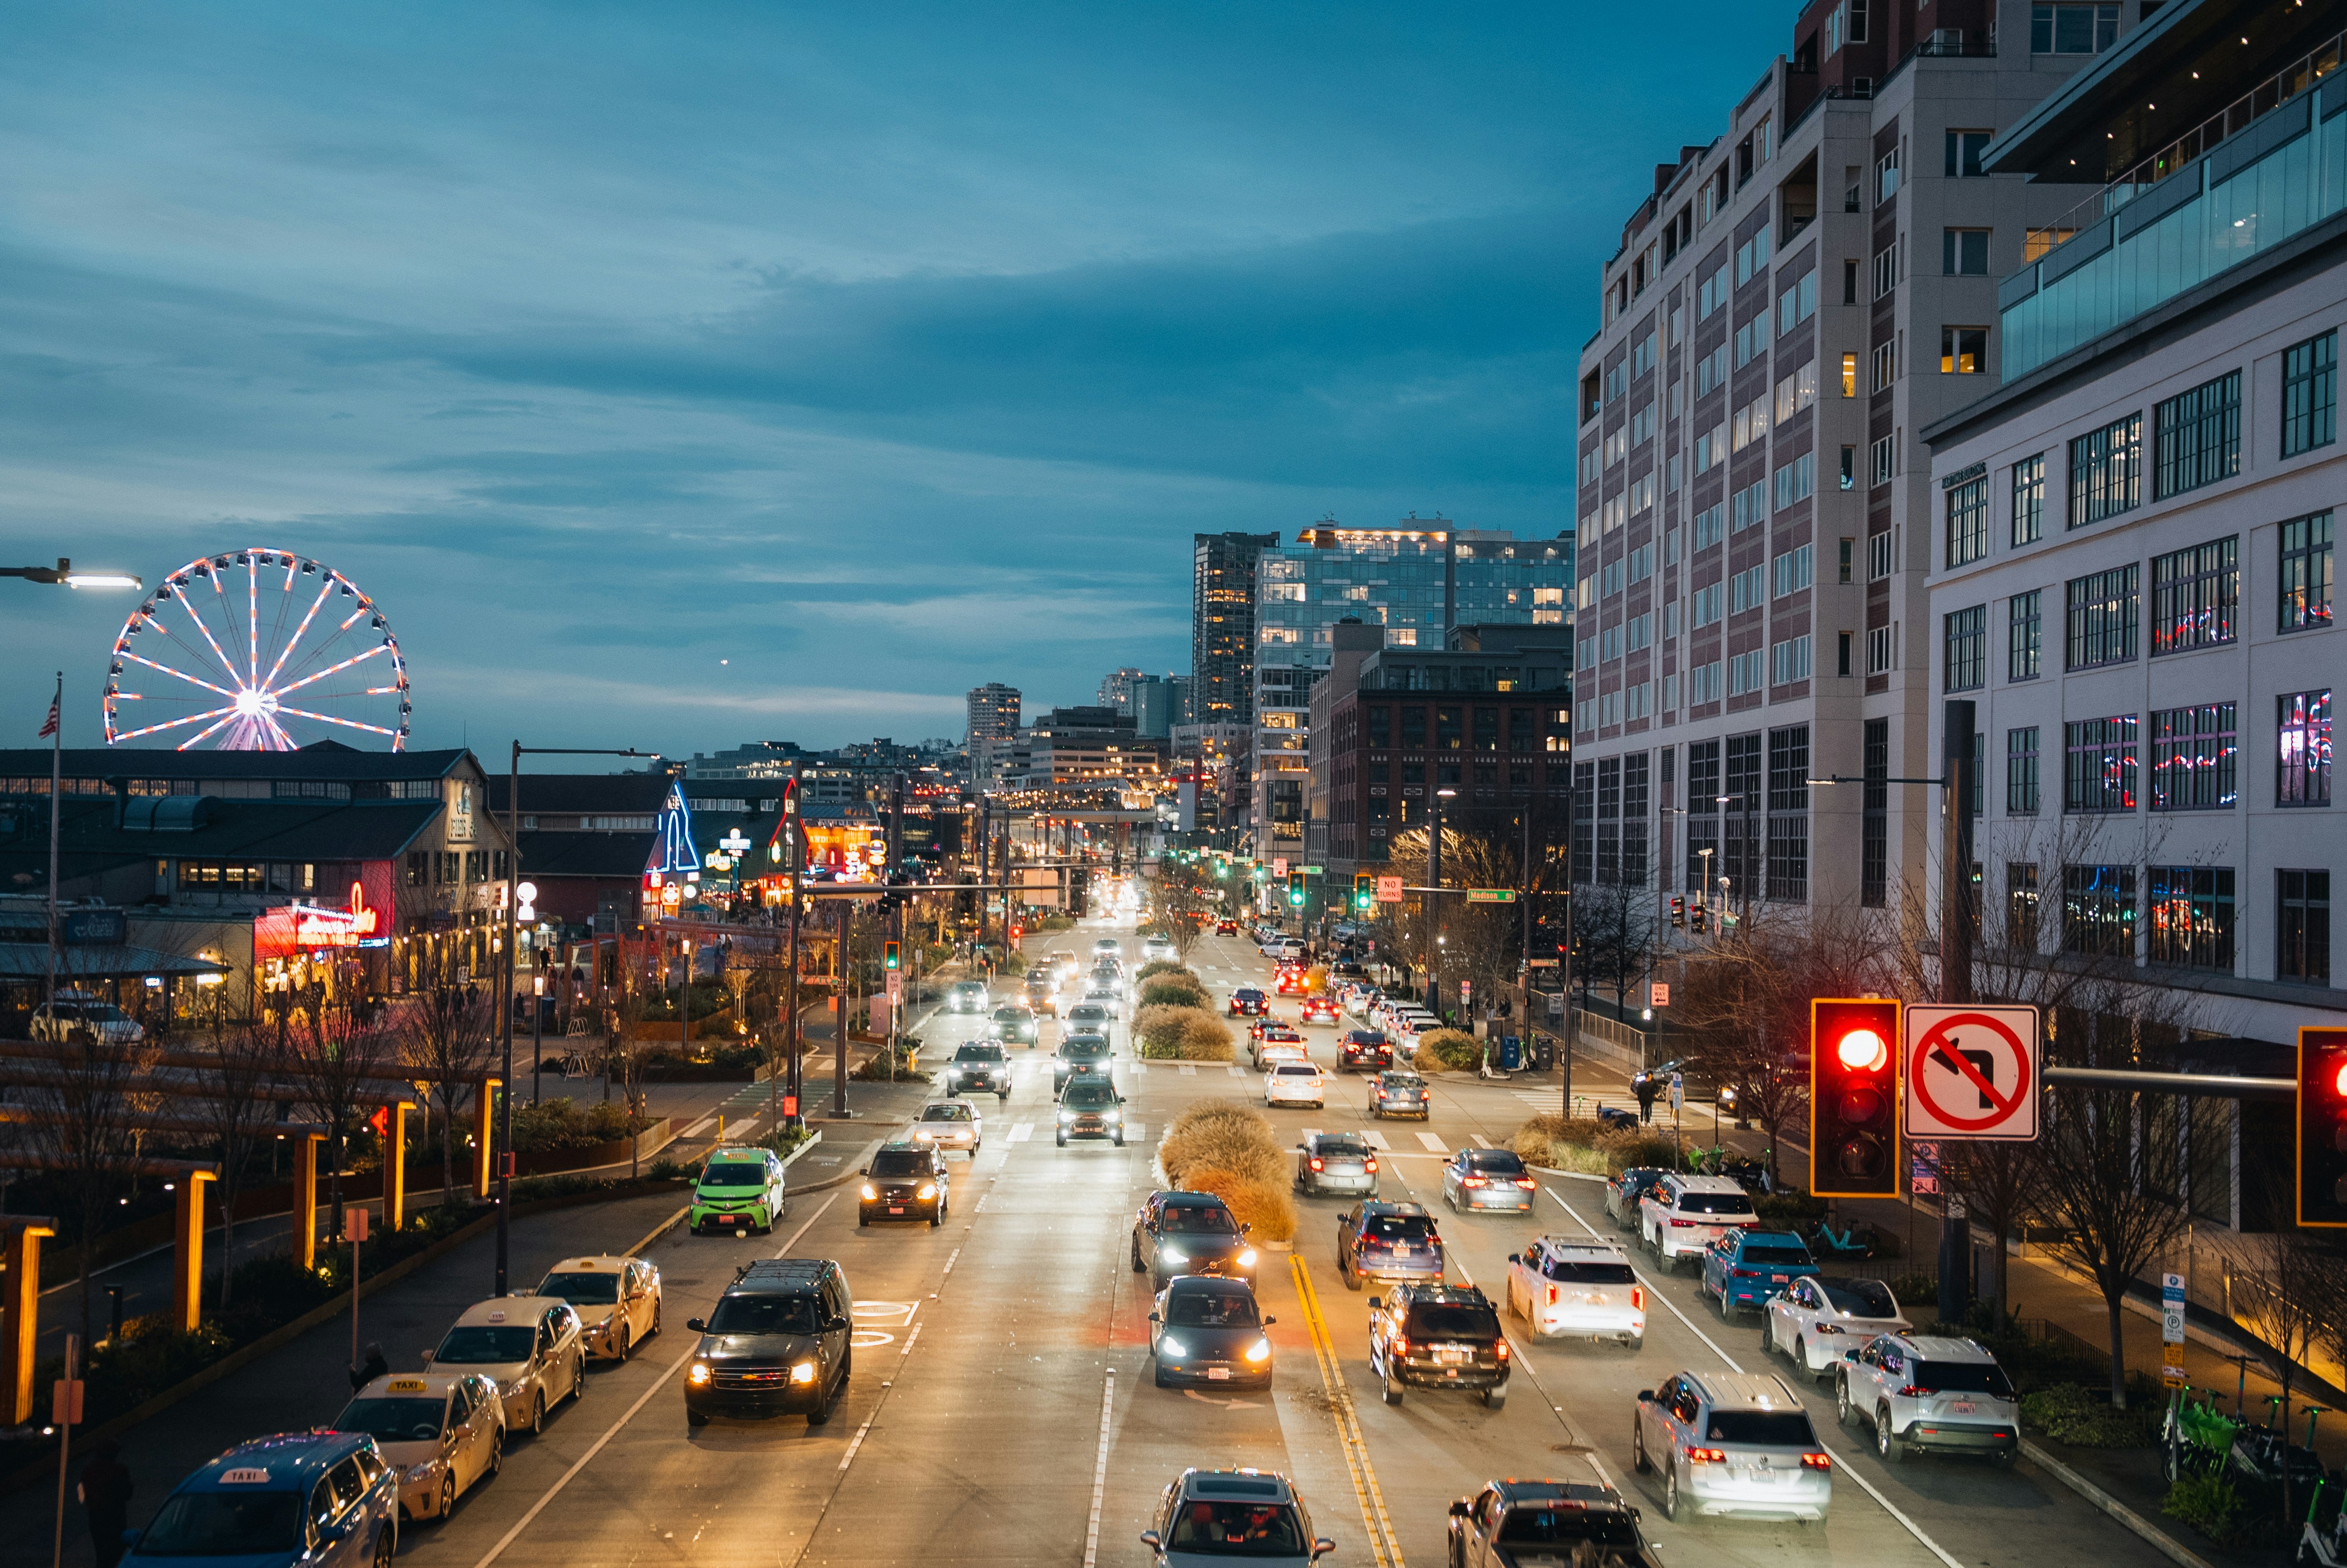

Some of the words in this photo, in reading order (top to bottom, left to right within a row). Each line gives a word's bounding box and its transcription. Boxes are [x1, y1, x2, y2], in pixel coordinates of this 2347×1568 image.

[2171, 1318, 2177, 1327] P
[396, 1381, 418, 1389] TAXI
[233, 1472, 256, 1481] TAXI
